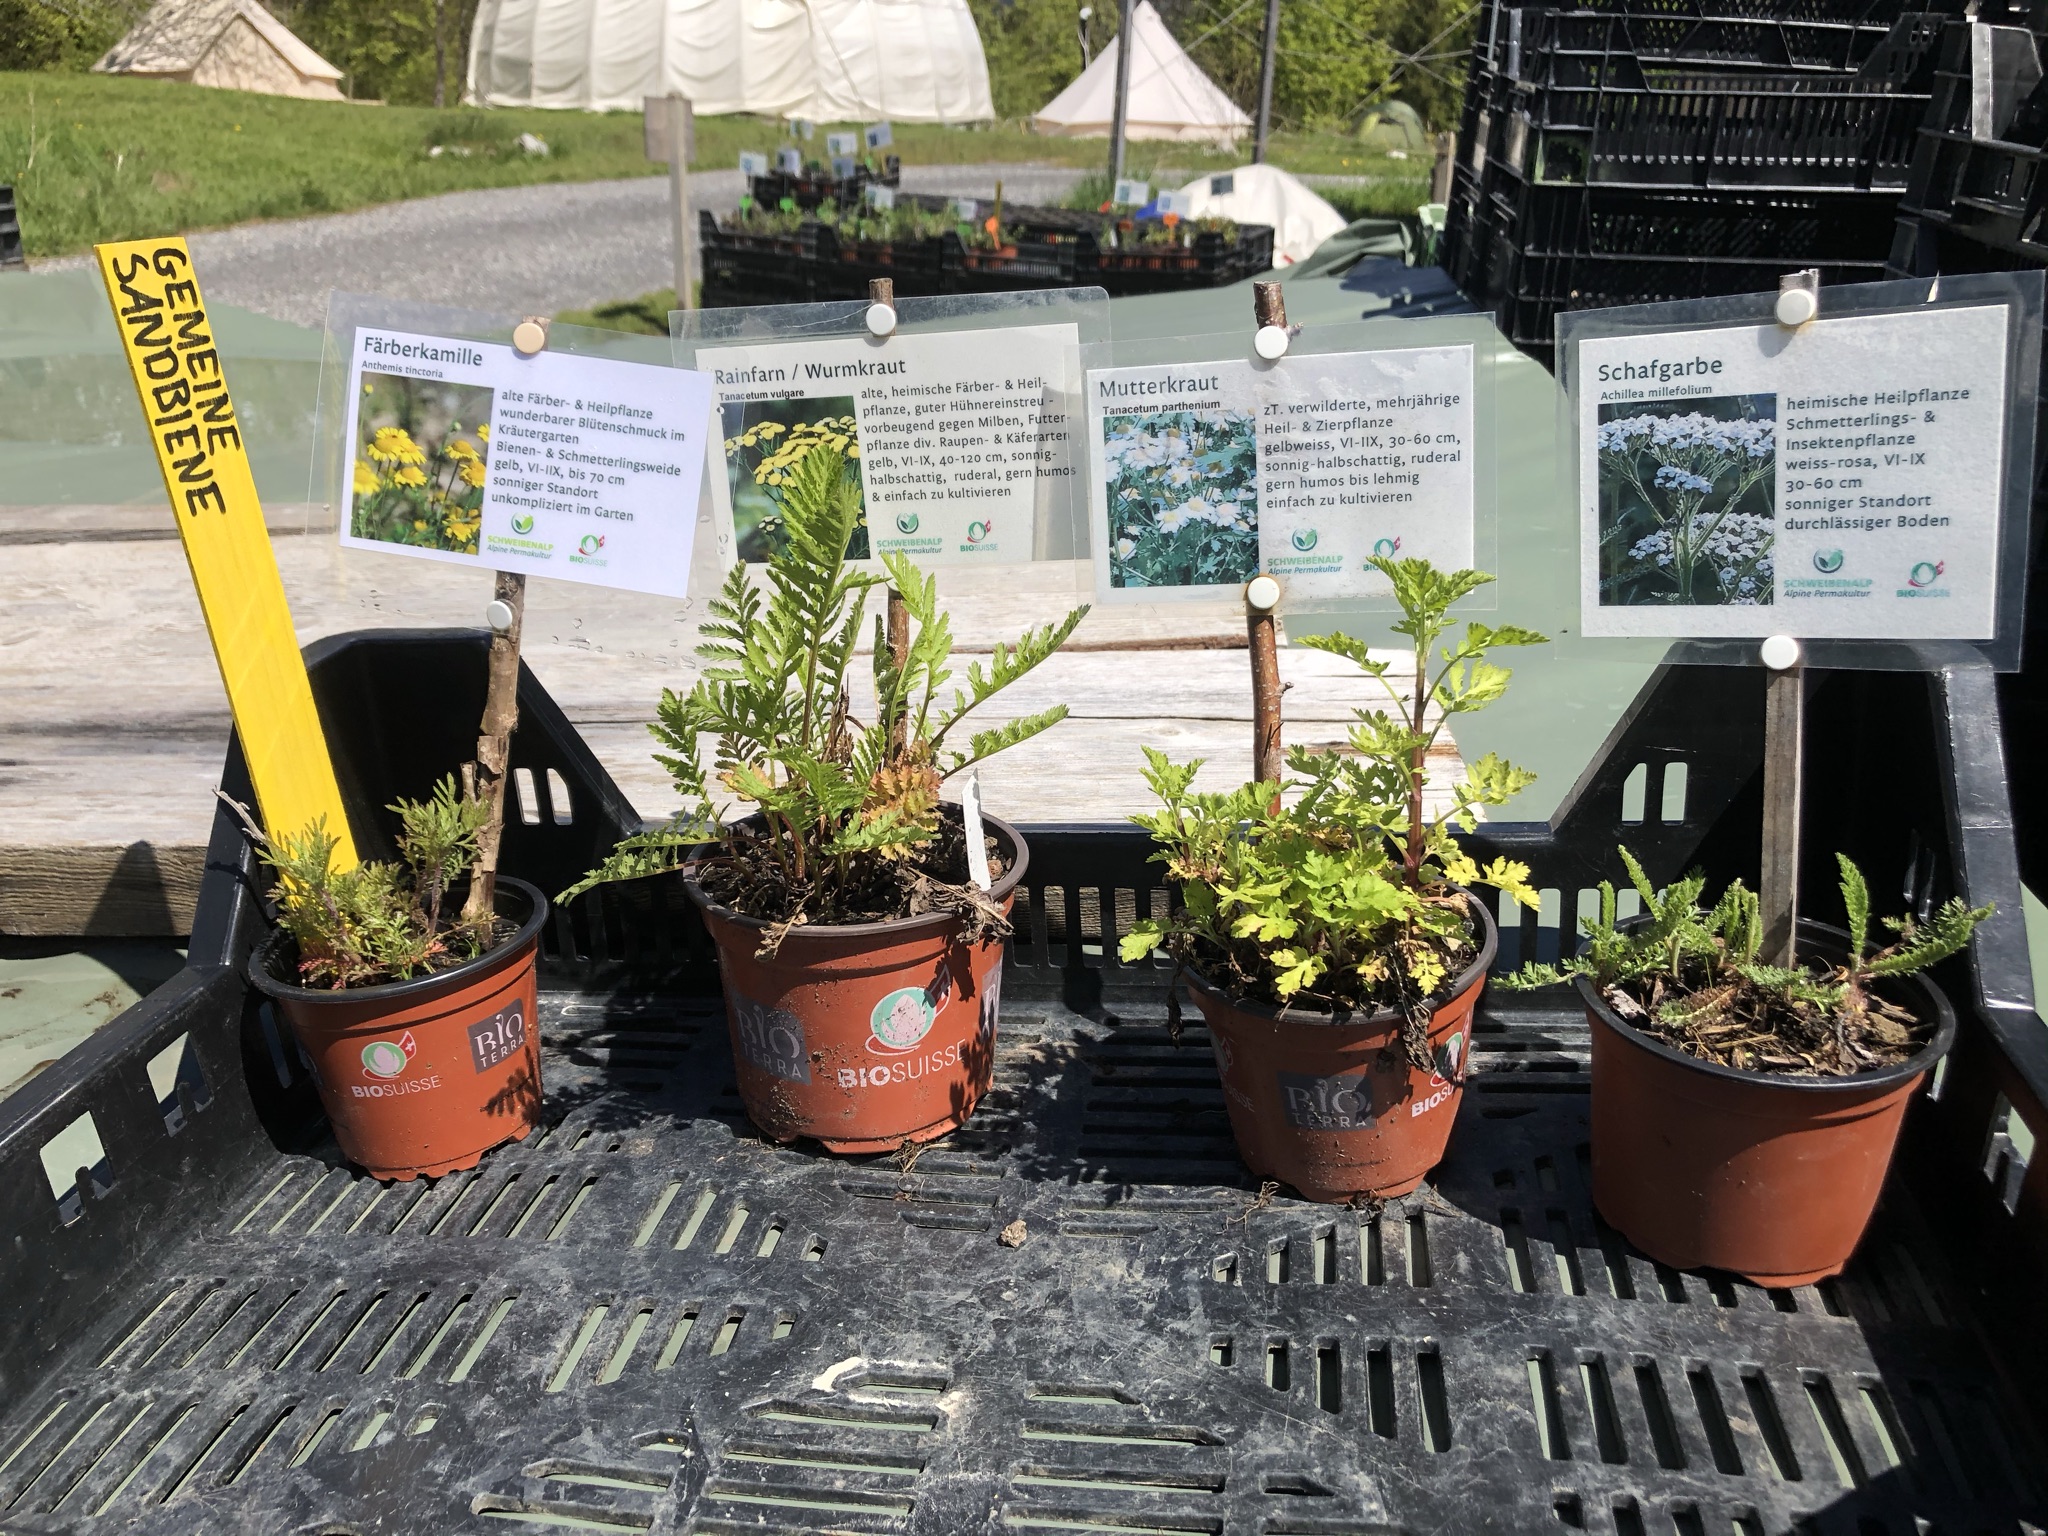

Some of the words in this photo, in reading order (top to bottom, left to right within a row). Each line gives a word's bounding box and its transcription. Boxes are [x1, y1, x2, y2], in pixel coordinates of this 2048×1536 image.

[152, 248, 240, 456] GEMEINE
[364, 336, 483, 366] Färberkamille
[361, 359, 403, 375] Anthemis
[404, 365, 444, 379] tinctoria
[714, 365, 786, 385] Rainfarn
[791, 363, 799, 381] /
[804, 359, 907, 380] Wurmkraut
[1598, 356, 1723, 383] Schafgarbe
[113, 253, 226, 517] SANDBIENE
[719, 391, 768, 401] Tanacetum
[771, 389, 805, 400] vulgare
[860, 386, 888, 401] alte,
[891, 382, 952, 398] heimische
[955, 380, 1000, 394] Färber-
[1004, 379, 1014, 391] &
[1018, 377, 1047, 389] Heil-
[1099, 375, 1219, 398] Mutterkraut
[1600, 388, 1645, 401] Achillea
[1647, 384, 1713, 398] millefolium
[501, 388, 525, 403] alte
[527, 392, 571, 408] Färber-
[574, 398, 584, 411] &
[586, 400, 654, 421] Heilpflanze
[862, 404, 911, 420] pflanze,
[914, 403, 947, 417] guter
[950, 397, 1044, 411] Hühnereinstreu
[1103, 404, 1159, 416] Tanacetum
[1162, 400, 1221, 414] parthenium
[1263, 401, 1284, 416] zT.
[1287, 398, 1371, 415] verwilderte,
[1376, 392, 1461, 410] mehrjährige
[1786, 393, 1869, 411] heimische
[1874, 387, 1971, 407] Heilpflanze
[499, 408, 576, 427] wunderbarer
[577, 416, 668, 440] Blütenschmuck
[670, 428, 685, 442] im
[863, 418, 935, 435] vorbeugend
[938, 419, 975, 433] gegen
[977, 414, 1024, 428] Milben,
[1264, 420, 1297, 435] Heil-
[1302, 421, 1312, 432] &
[1316, 417, 1393, 432] Zierpflanze
[1786, 412, 1917, 431] Schmetterlings-
[1923, 410, 1936, 424] &
[498, 423, 580, 445] Kräutergarten
[866, 438, 910, 454] pflanze
[913, 436, 936, 449] div.
[939, 436, 990, 449] Raupen-
[993, 433, 1003, 445] &
[1007, 432, 1070, 444] Käferarten
[1264, 440, 1335, 456] gelbweiss,
[1339, 435, 1384, 450] VI-IIX,
[1388, 433, 1431, 449] 30-60
[1435, 433, 1461, 446] cm,
[1786, 432, 1916, 451] Insektenpflanze
[496, 440, 542, 457] Bienen-
[545, 447, 555, 459] &
[557, 448, 682, 477] Schmetterlingsweide
[868, 456, 898, 472] gelb,
[900, 454, 936, 468] VI-IX,
[938, 453, 982, 468] 40-120
[985, 453, 1008, 465] cm,
[1012, 449, 1057, 462] sonnig-
[1265, 454, 1406, 472] sonnig-halbschattig,
[1411, 449, 1461, 464] ruderal
[1786, 457, 1878, 470] weiss-rosa,
[1883, 452, 1926, 467] VI-IX
[493, 459, 524, 474] gelb,
[527, 461, 565, 480] VI-IIX,
[568, 466, 586, 481] bis
[589, 472, 605, 484] 70
[607, 475, 626, 486] cm
[869, 471, 947, 486] halbschattig,
[954, 467, 1002, 482] ruderal,
[1005, 469, 1033, 482] gern
[1036, 466, 1077, 477] humos
[1266, 480, 1295, 493] gern
[1300, 476, 1345, 489] humos
[1350, 474, 1368, 485] bis
[1374, 472, 1420, 485] lehmig
[492, 476, 545, 493] sonniger
[546, 481, 599, 500] Standort
[871, 491, 881, 503] &
[884, 488, 928, 502] einfach
[930, 491, 945, 500] zu
[947, 486, 1012, 500] kultivieren
[1785, 477, 1835, 494] 30-60
[1838, 478, 1864, 489] cm
[491, 492, 574, 514] unkompliziert
[575, 502, 592, 516] im
[593, 505, 634, 522] Garten
[1266, 495, 1315, 508] einfach
[1319, 496, 1335, 507] zu
[1339, 491, 1413, 505] kultivieren
[1784, 496, 1855, 513] sonniger
[1858, 493, 1932, 509] Standort
[1784, 515, 1892, 532] durchlässiger
[1896, 513, 1951, 528] Boden
[487, 535, 554, 551] SCHWEIBENALP
[487, 544, 508, 553] Alpine
[510, 547, 552, 559] Permakultur
[877, 538, 943, 548] SCHWEIBENALP
[902, 547, 942, 555] Permakultur
[1267, 556, 1343, 566] SCHWEIBENALP
[1268, 566, 1293, 576] Alpine
[1294, 565, 1342, 574] Permakultur
[1784, 590, 1812, 598] Alpine
[480, 1034, 524, 1068] TERRA
[742, 1041, 802, 1078] TERRA
